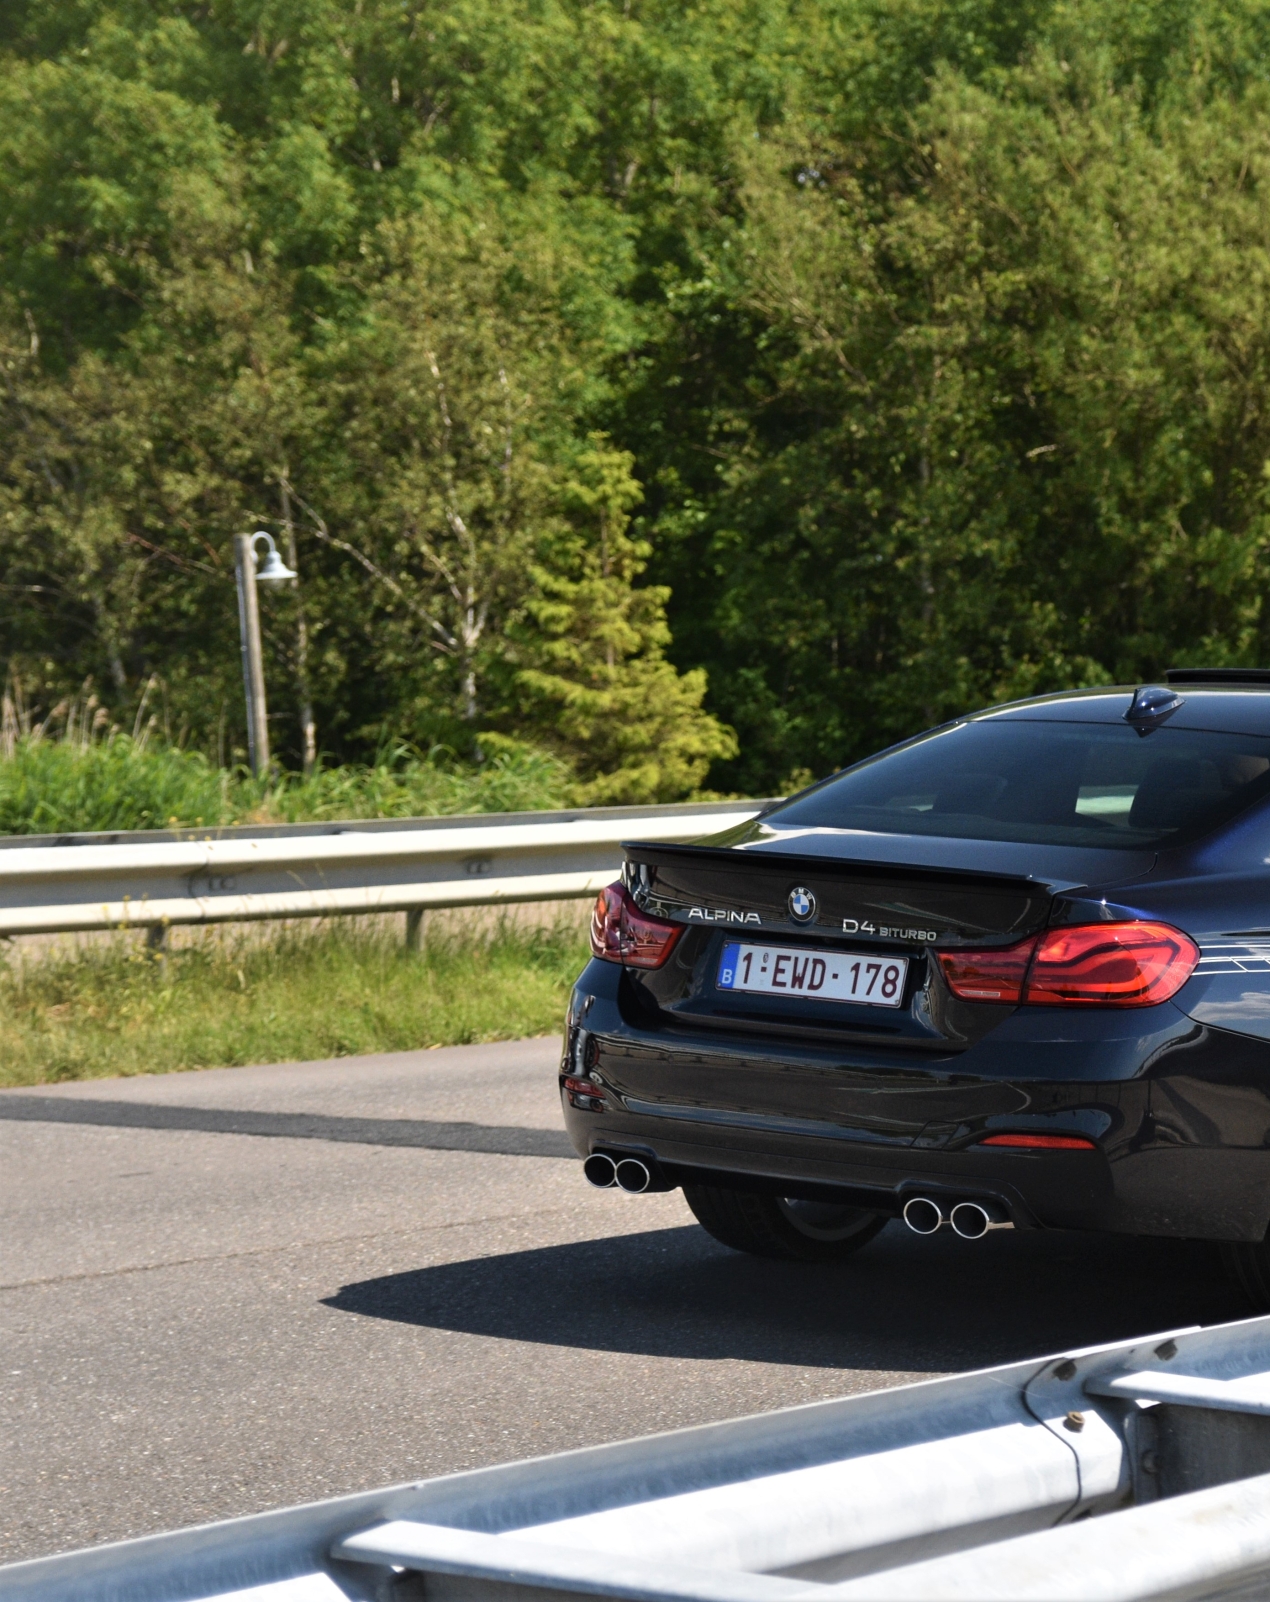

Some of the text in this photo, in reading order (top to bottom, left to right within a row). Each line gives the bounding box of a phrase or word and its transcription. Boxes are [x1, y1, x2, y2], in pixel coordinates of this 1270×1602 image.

[790, 888, 813, 900] BMW
[688, 908, 762, 925] ALPINA
[842, 919, 937, 941] D4 BITURBO
[721, 969, 733, 984] B
